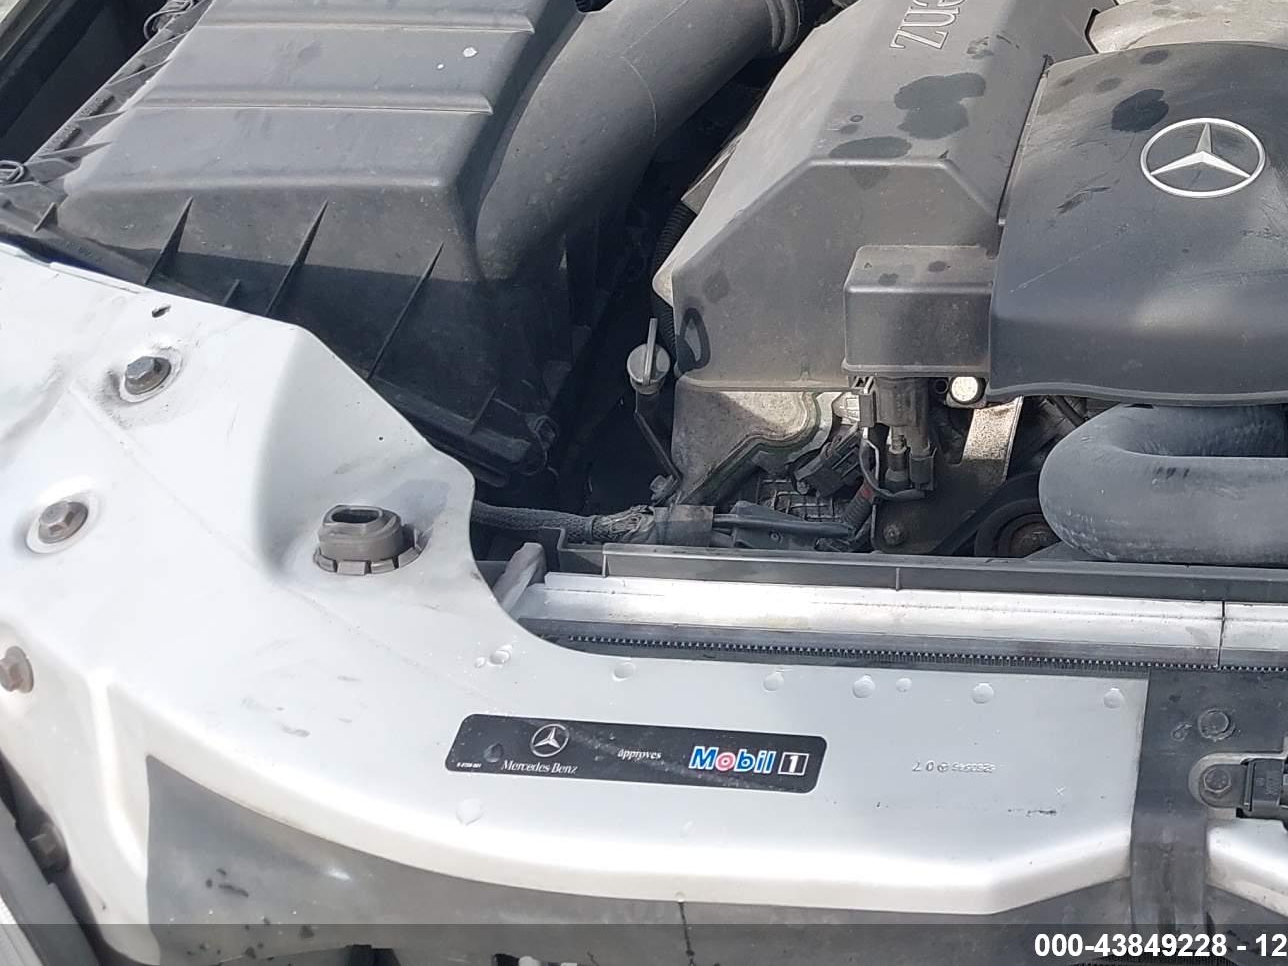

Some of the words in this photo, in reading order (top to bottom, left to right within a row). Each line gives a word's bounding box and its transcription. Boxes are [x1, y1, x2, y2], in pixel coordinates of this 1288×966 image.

[617, 748, 662, 761] approves
[688, 745, 776, 774] Mobil
[501, 760, 550, 773] Mercedes
[551, 764, 578, 774] Benz
